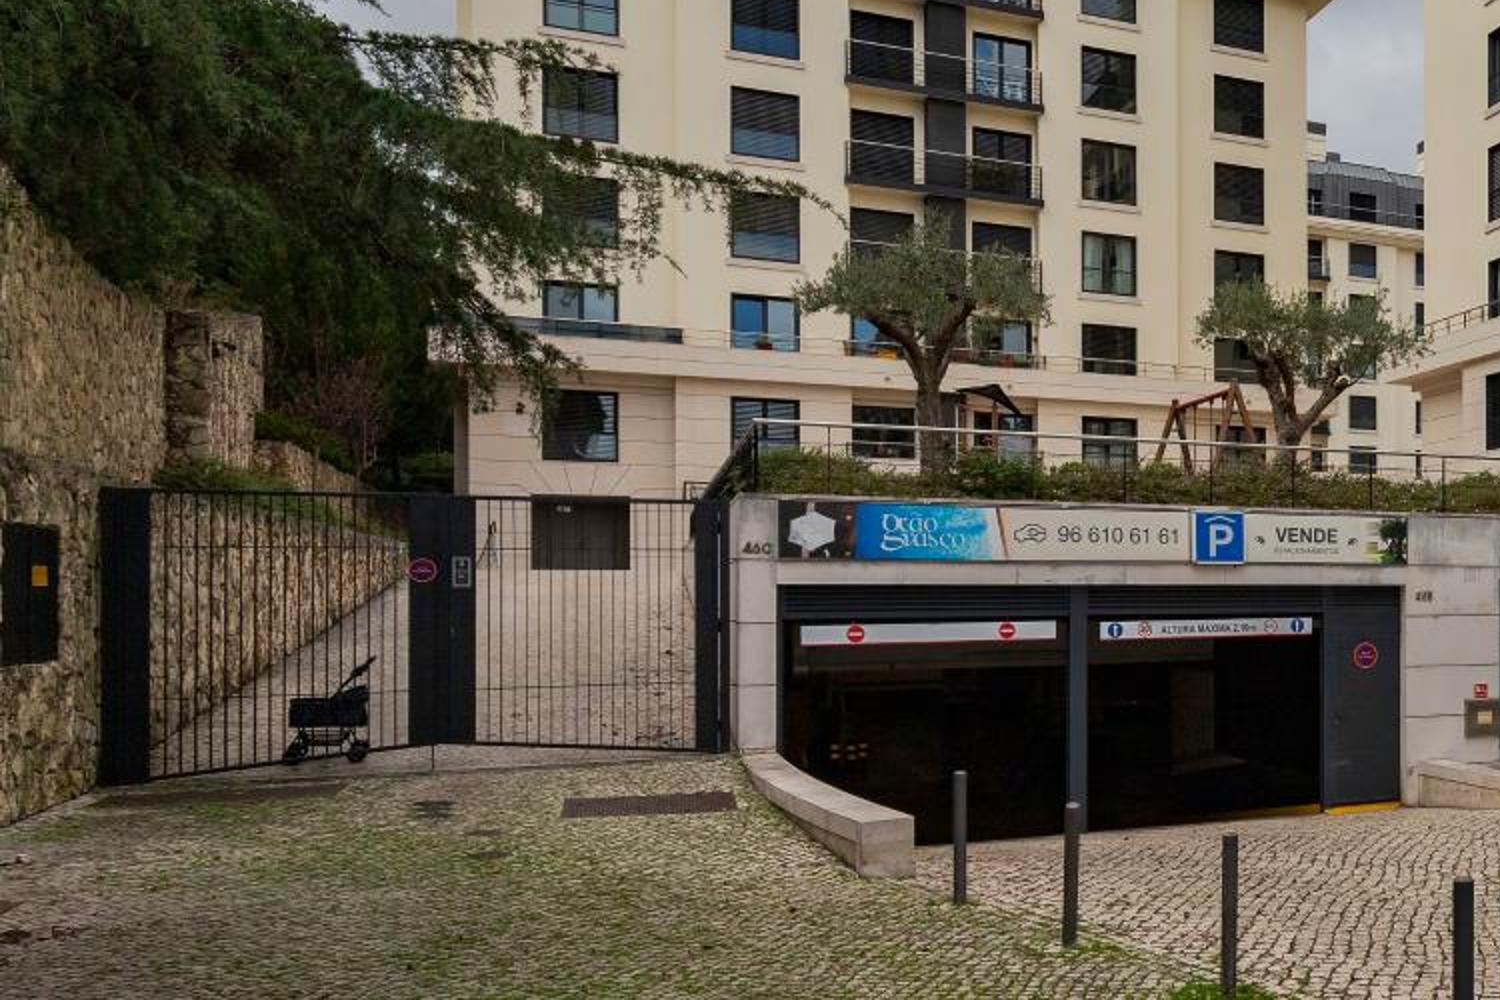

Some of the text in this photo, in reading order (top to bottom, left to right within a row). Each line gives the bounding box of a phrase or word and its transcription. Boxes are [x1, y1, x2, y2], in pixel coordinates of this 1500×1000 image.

[1057, 525, 1179, 545] 96 610 61 61
[1209, 523, 1234, 558] P
[1275, 527, 1339, 543] VENDE
